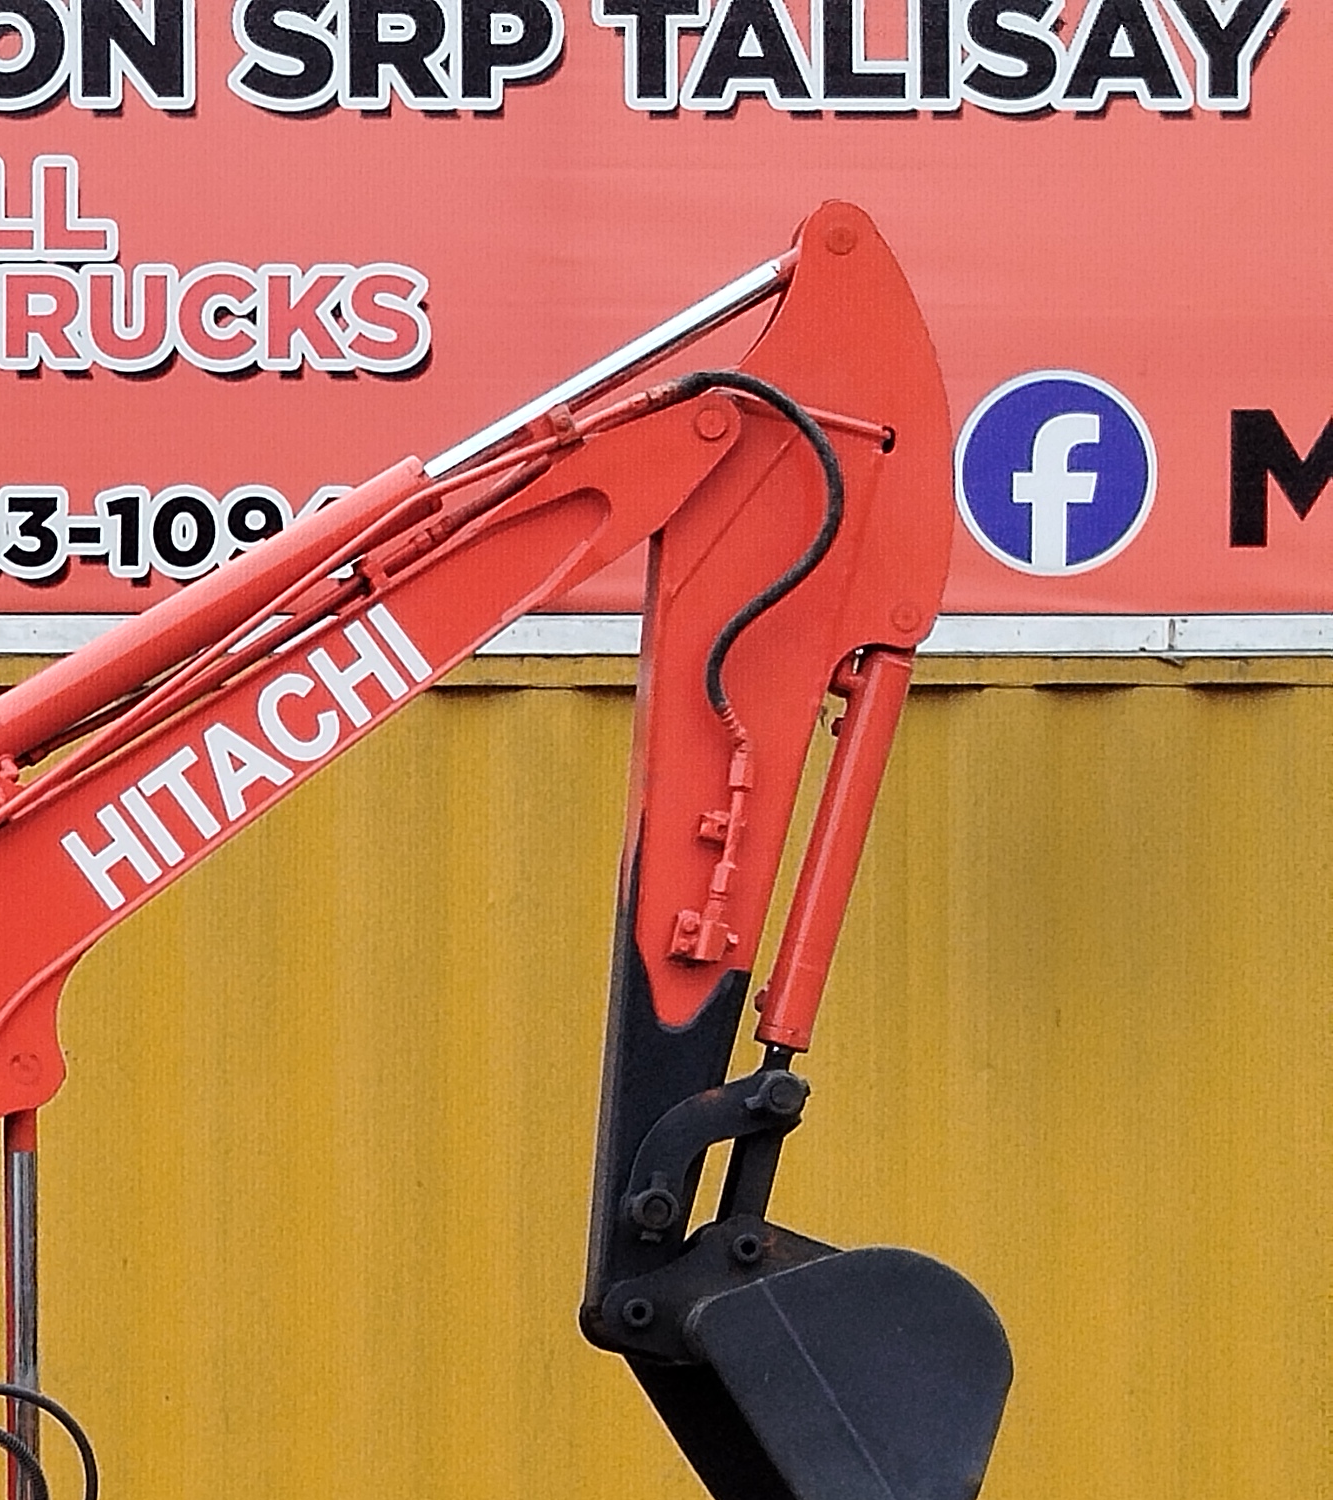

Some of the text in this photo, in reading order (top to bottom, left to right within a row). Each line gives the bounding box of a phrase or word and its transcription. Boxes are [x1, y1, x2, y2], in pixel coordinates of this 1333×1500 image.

[229, 0, 563, 110] SRP
[594, 0, 1286, 111] TALISAY
[60, 602, 434, 911] HITACHI
